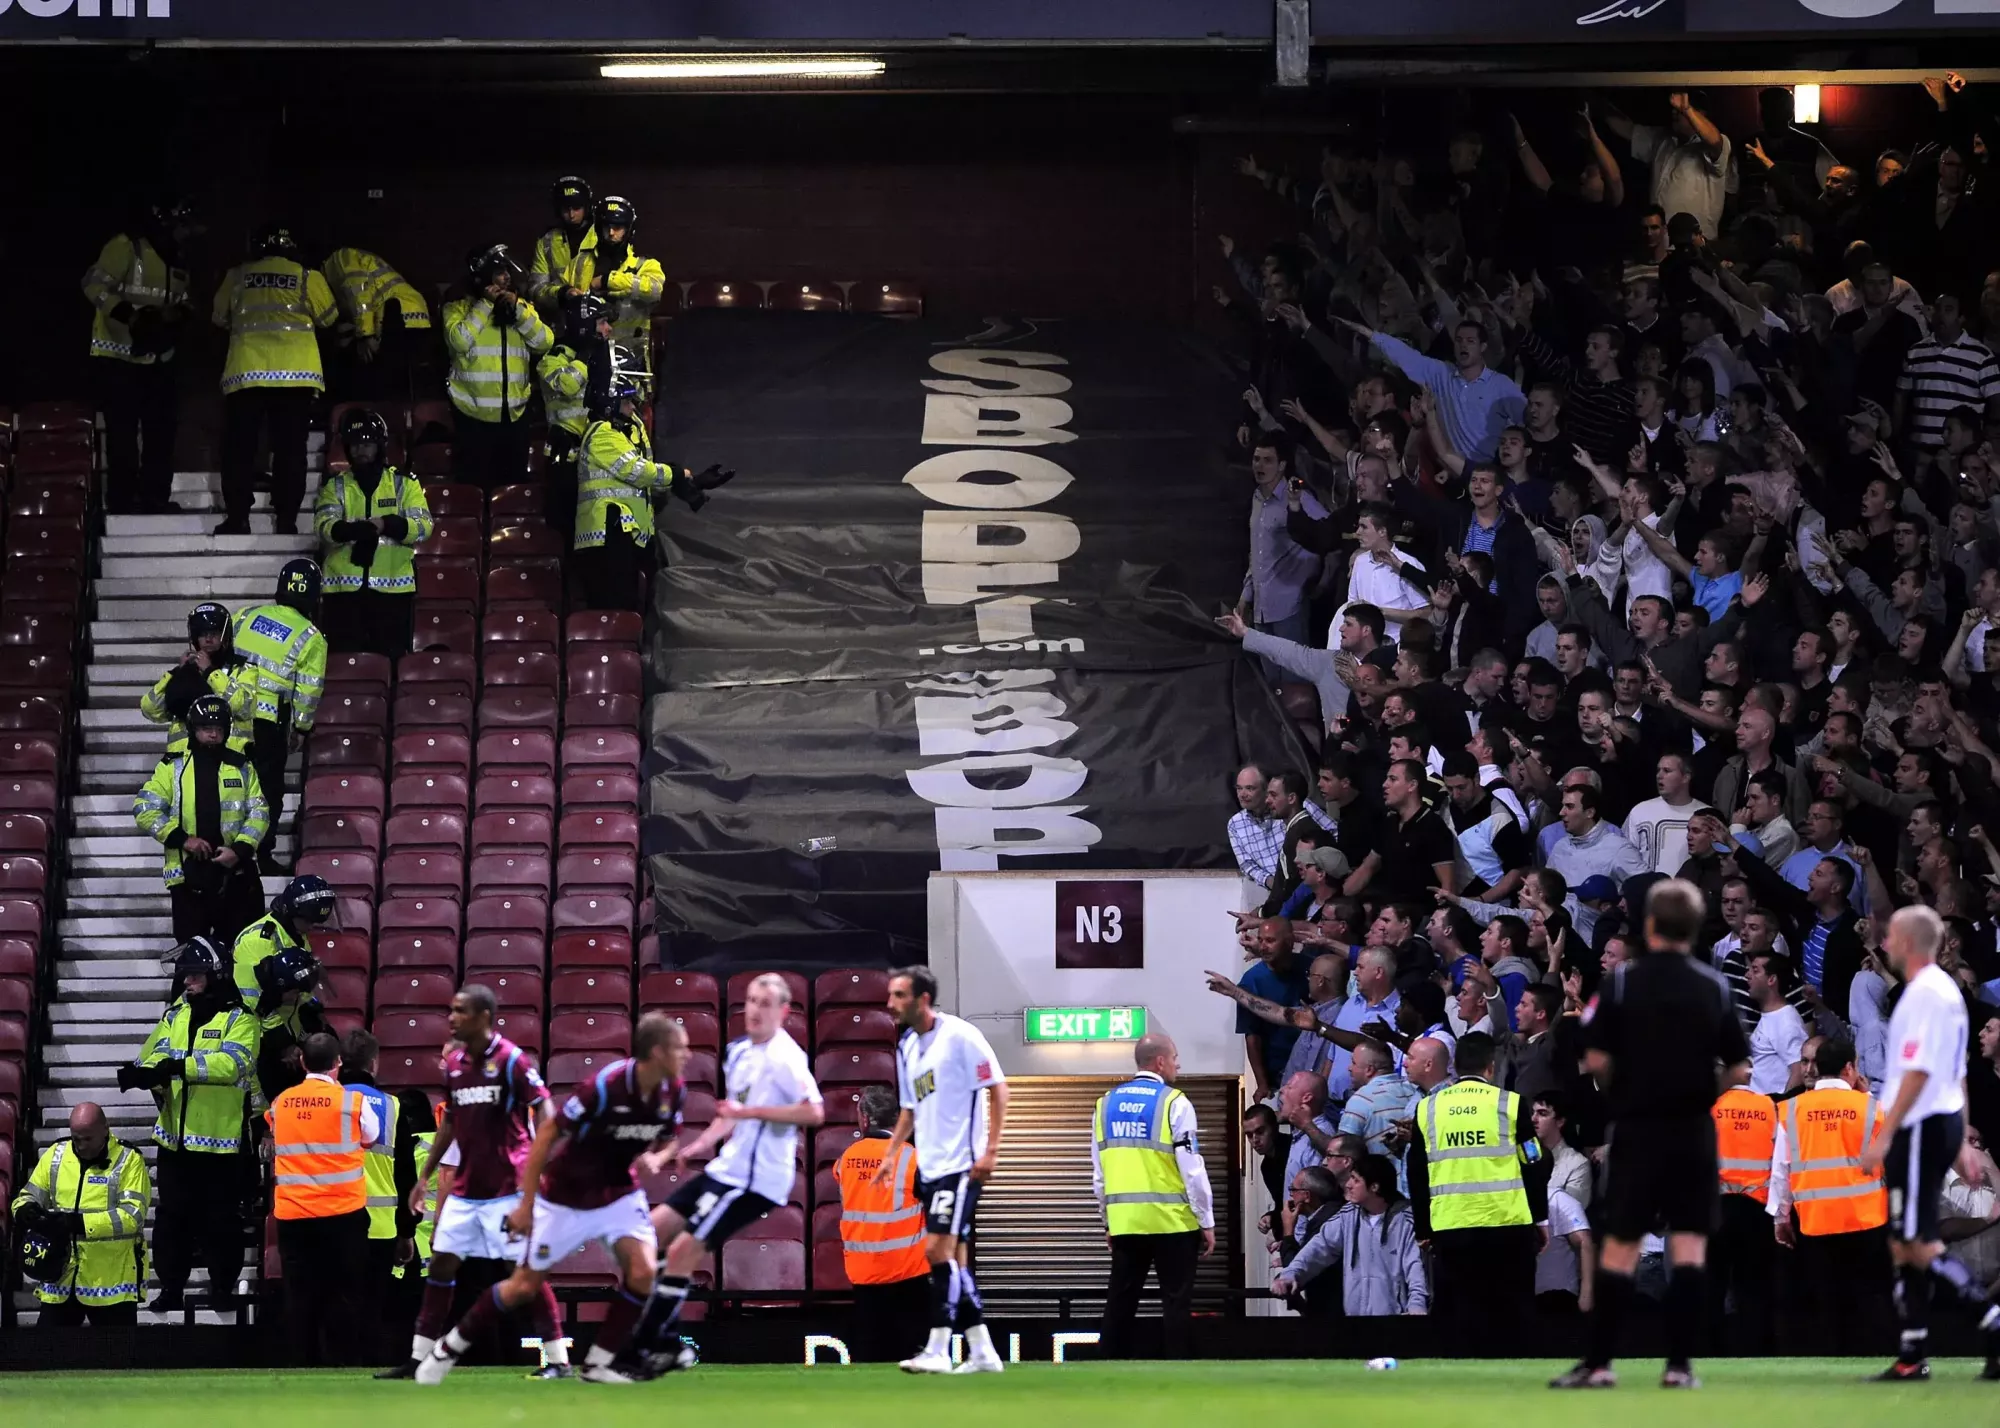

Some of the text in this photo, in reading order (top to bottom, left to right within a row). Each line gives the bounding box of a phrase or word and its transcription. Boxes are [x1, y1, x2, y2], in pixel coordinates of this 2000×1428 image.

[607, 203, 619, 211] MP
[245, 275, 297, 289] POLICE
[292, 572, 304, 581] MP
[253, 620, 287, 640] POLICE
[208, 704, 219, 712] MP
[1076, 905, 1123, 943] N3
[1039, 1013, 1102, 1037] EXIT
[1443, 1087, 1492, 1096] SECURITY
[283, 1096, 331, 1108] STEWARD
[297, 1111, 312, 1120] 445
[1449, 1106, 1477, 1115] 5048
[1717, 1109, 1767, 1121] STEWARD
[1807, 1109, 1857, 1121] STEWARD
[1112, 1121, 1147, 1138] WISE
[1446, 1130, 1486, 1146] WISE
[847, 1158, 882, 1168] STEWAR
[930, 1190, 955, 1215] 12
